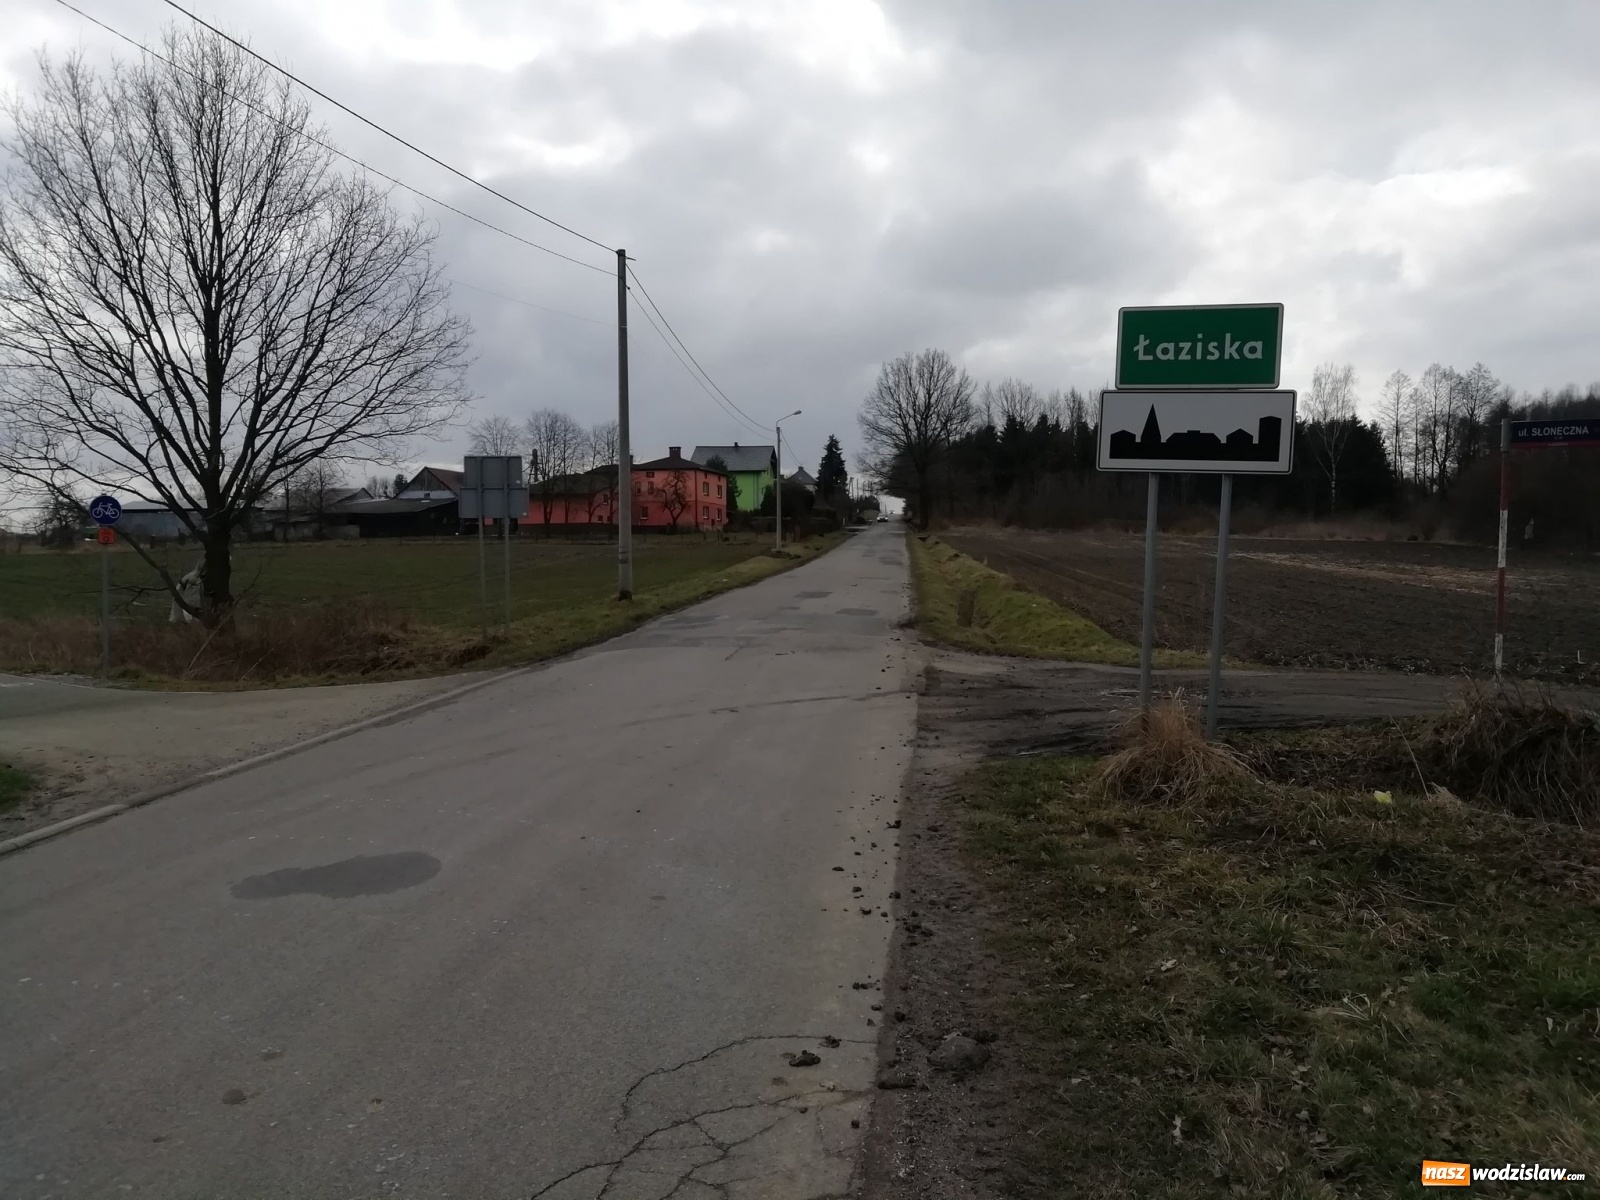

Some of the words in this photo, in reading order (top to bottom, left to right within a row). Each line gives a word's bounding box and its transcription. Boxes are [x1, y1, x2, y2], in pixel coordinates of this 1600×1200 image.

[1133, 333, 1263, 360] Łaziska
[1518, 428, 1529, 437] ul.
[1531, 426, 1589, 437] SŁONECZNA
